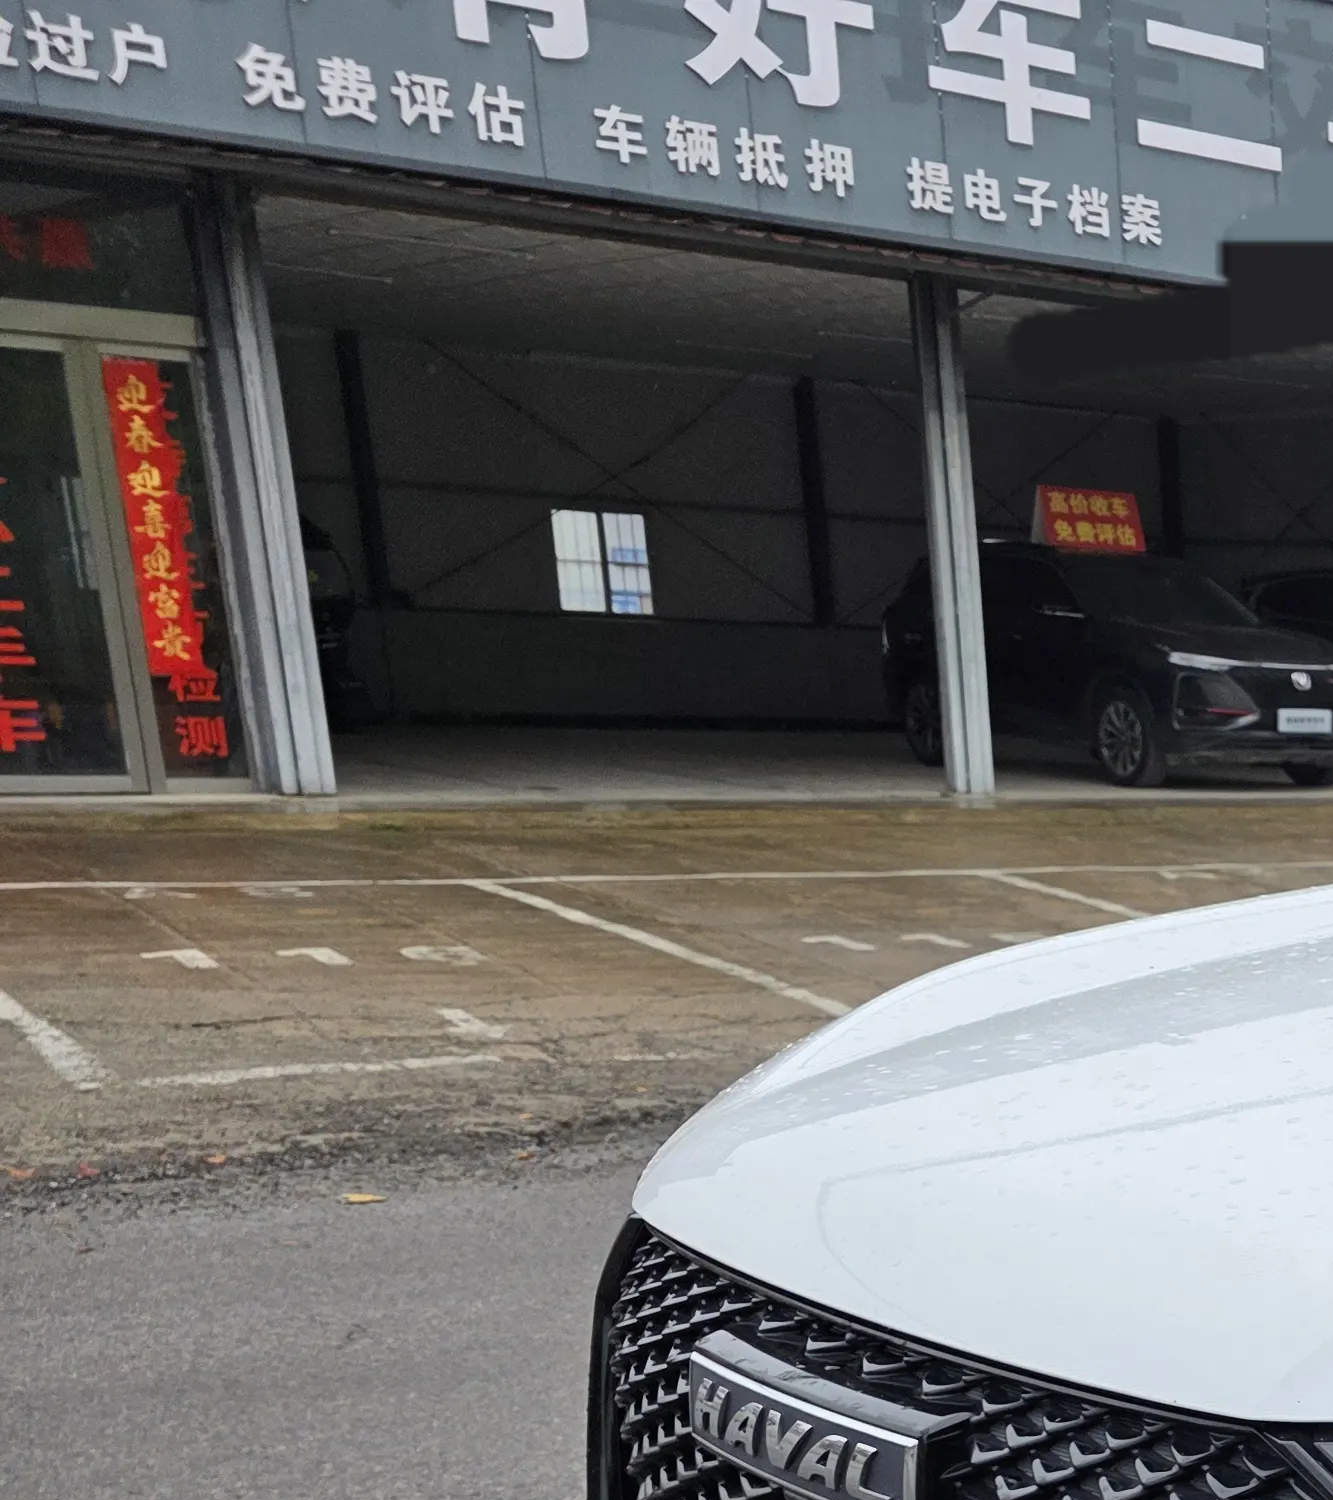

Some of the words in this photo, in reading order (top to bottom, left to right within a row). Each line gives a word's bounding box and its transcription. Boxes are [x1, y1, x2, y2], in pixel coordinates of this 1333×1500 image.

[236, 42, 526, 149] 免费评估
[594, 104, 854, 199] 车辆抵押
[906, 156, 1164, 248] 提电子档案
[116, 372, 192, 661] 迎春迎喜迎富贵
[1053, 518, 1137, 546] 免费评估
